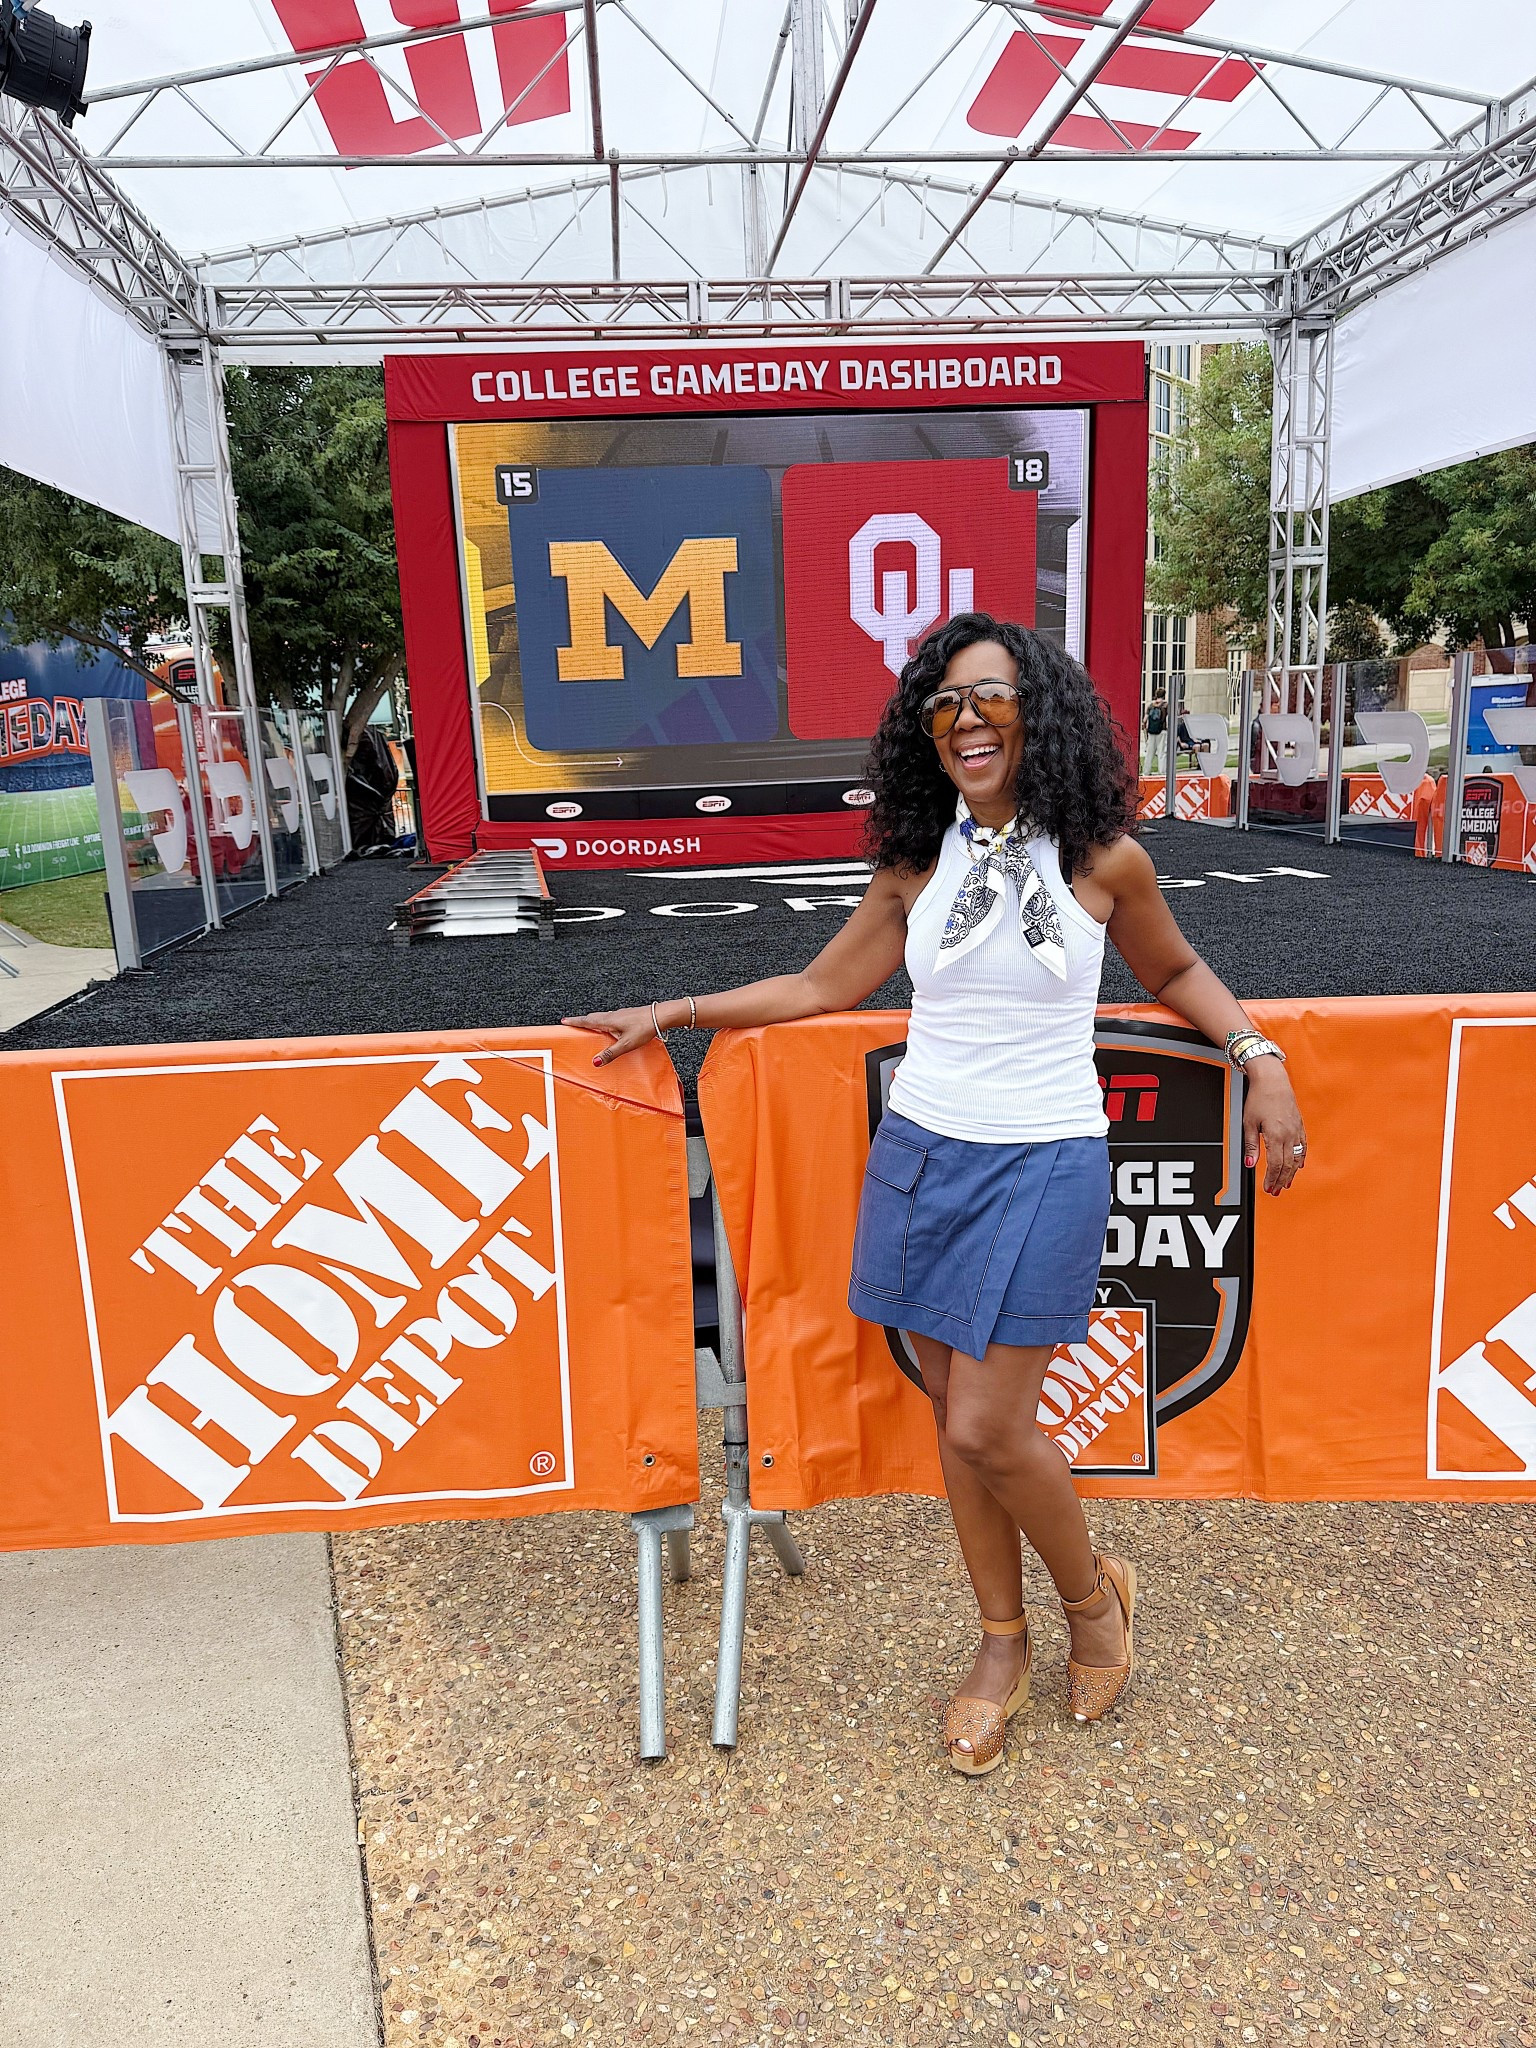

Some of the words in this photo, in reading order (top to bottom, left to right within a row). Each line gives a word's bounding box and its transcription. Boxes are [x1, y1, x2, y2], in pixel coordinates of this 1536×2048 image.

[472, 365, 641, 403] COLLEGE
[650, 360, 830, 396] GAMEDAY
[840, 355, 1062, 390] DASHBOARD
[1014, 458, 1044, 484] 18
[500, 471, 533, 498] 15
[548, 537, 743, 682] M
[552, 805, 576, 815] ESPN
[702, 799, 726, 808] ESPN
[1461, 807, 1495, 819] COLLEGE
[1461, 820, 1499, 833] AMEDAY
[576, 837, 701, 856] DOORDASH
[129, 1112, 324, 1296] THE
[104, 1058, 550, 1510] HOME
[290, 1218, 559, 1502] DEPOT
